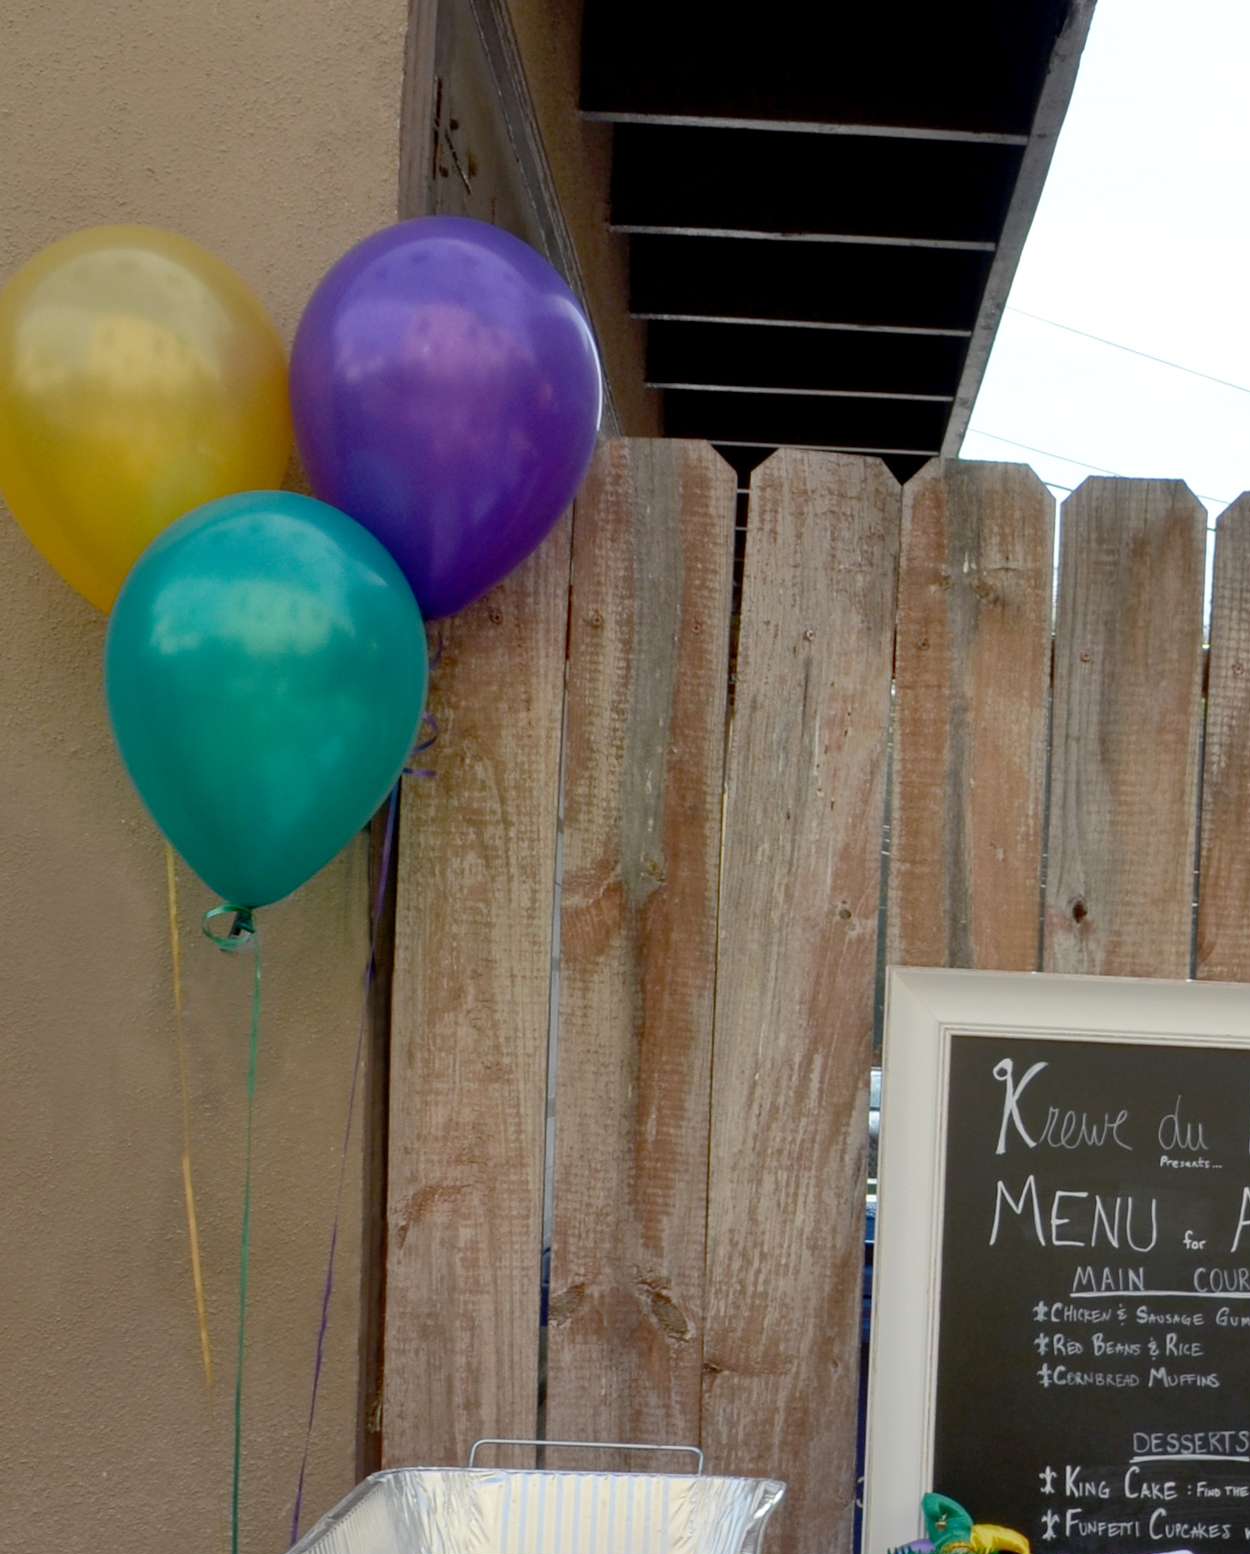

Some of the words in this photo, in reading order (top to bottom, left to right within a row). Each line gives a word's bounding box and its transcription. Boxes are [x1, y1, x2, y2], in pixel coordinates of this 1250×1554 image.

[992, 1058, 1133, 1155] Krewe
[1157, 1094, 1209, 1151] du
[989, 1174, 1157, 1252] MENU
[1183, 1230, 1207, 1250] for
[1072, 1266, 1146, 1292] MAIN
[1050, 1302, 1112, 1324] CHICKEN
[1136, 1305, 1205, 1326] SAUSAGE
[1053, 1333, 1083, 1356] RED
[1092, 1333, 1141, 1356] BEANS
[1166, 1333, 1203, 1356] RICE
[1053, 1365, 1140, 1387] CORNBREAD
[1148, 1366, 1220, 1388] MUFFINS
[1133, 1431, 1250, 1454] DESSERTS
[1065, 1465, 1110, 1498] KING
[1197, 1481, 1221, 1498] FIND
[1225, 1485, 1250, 1497] THE
[1065, 1508, 1140, 1537] FUNFETTI
[1150, 1507, 1231, 1540] CUPCAKES
